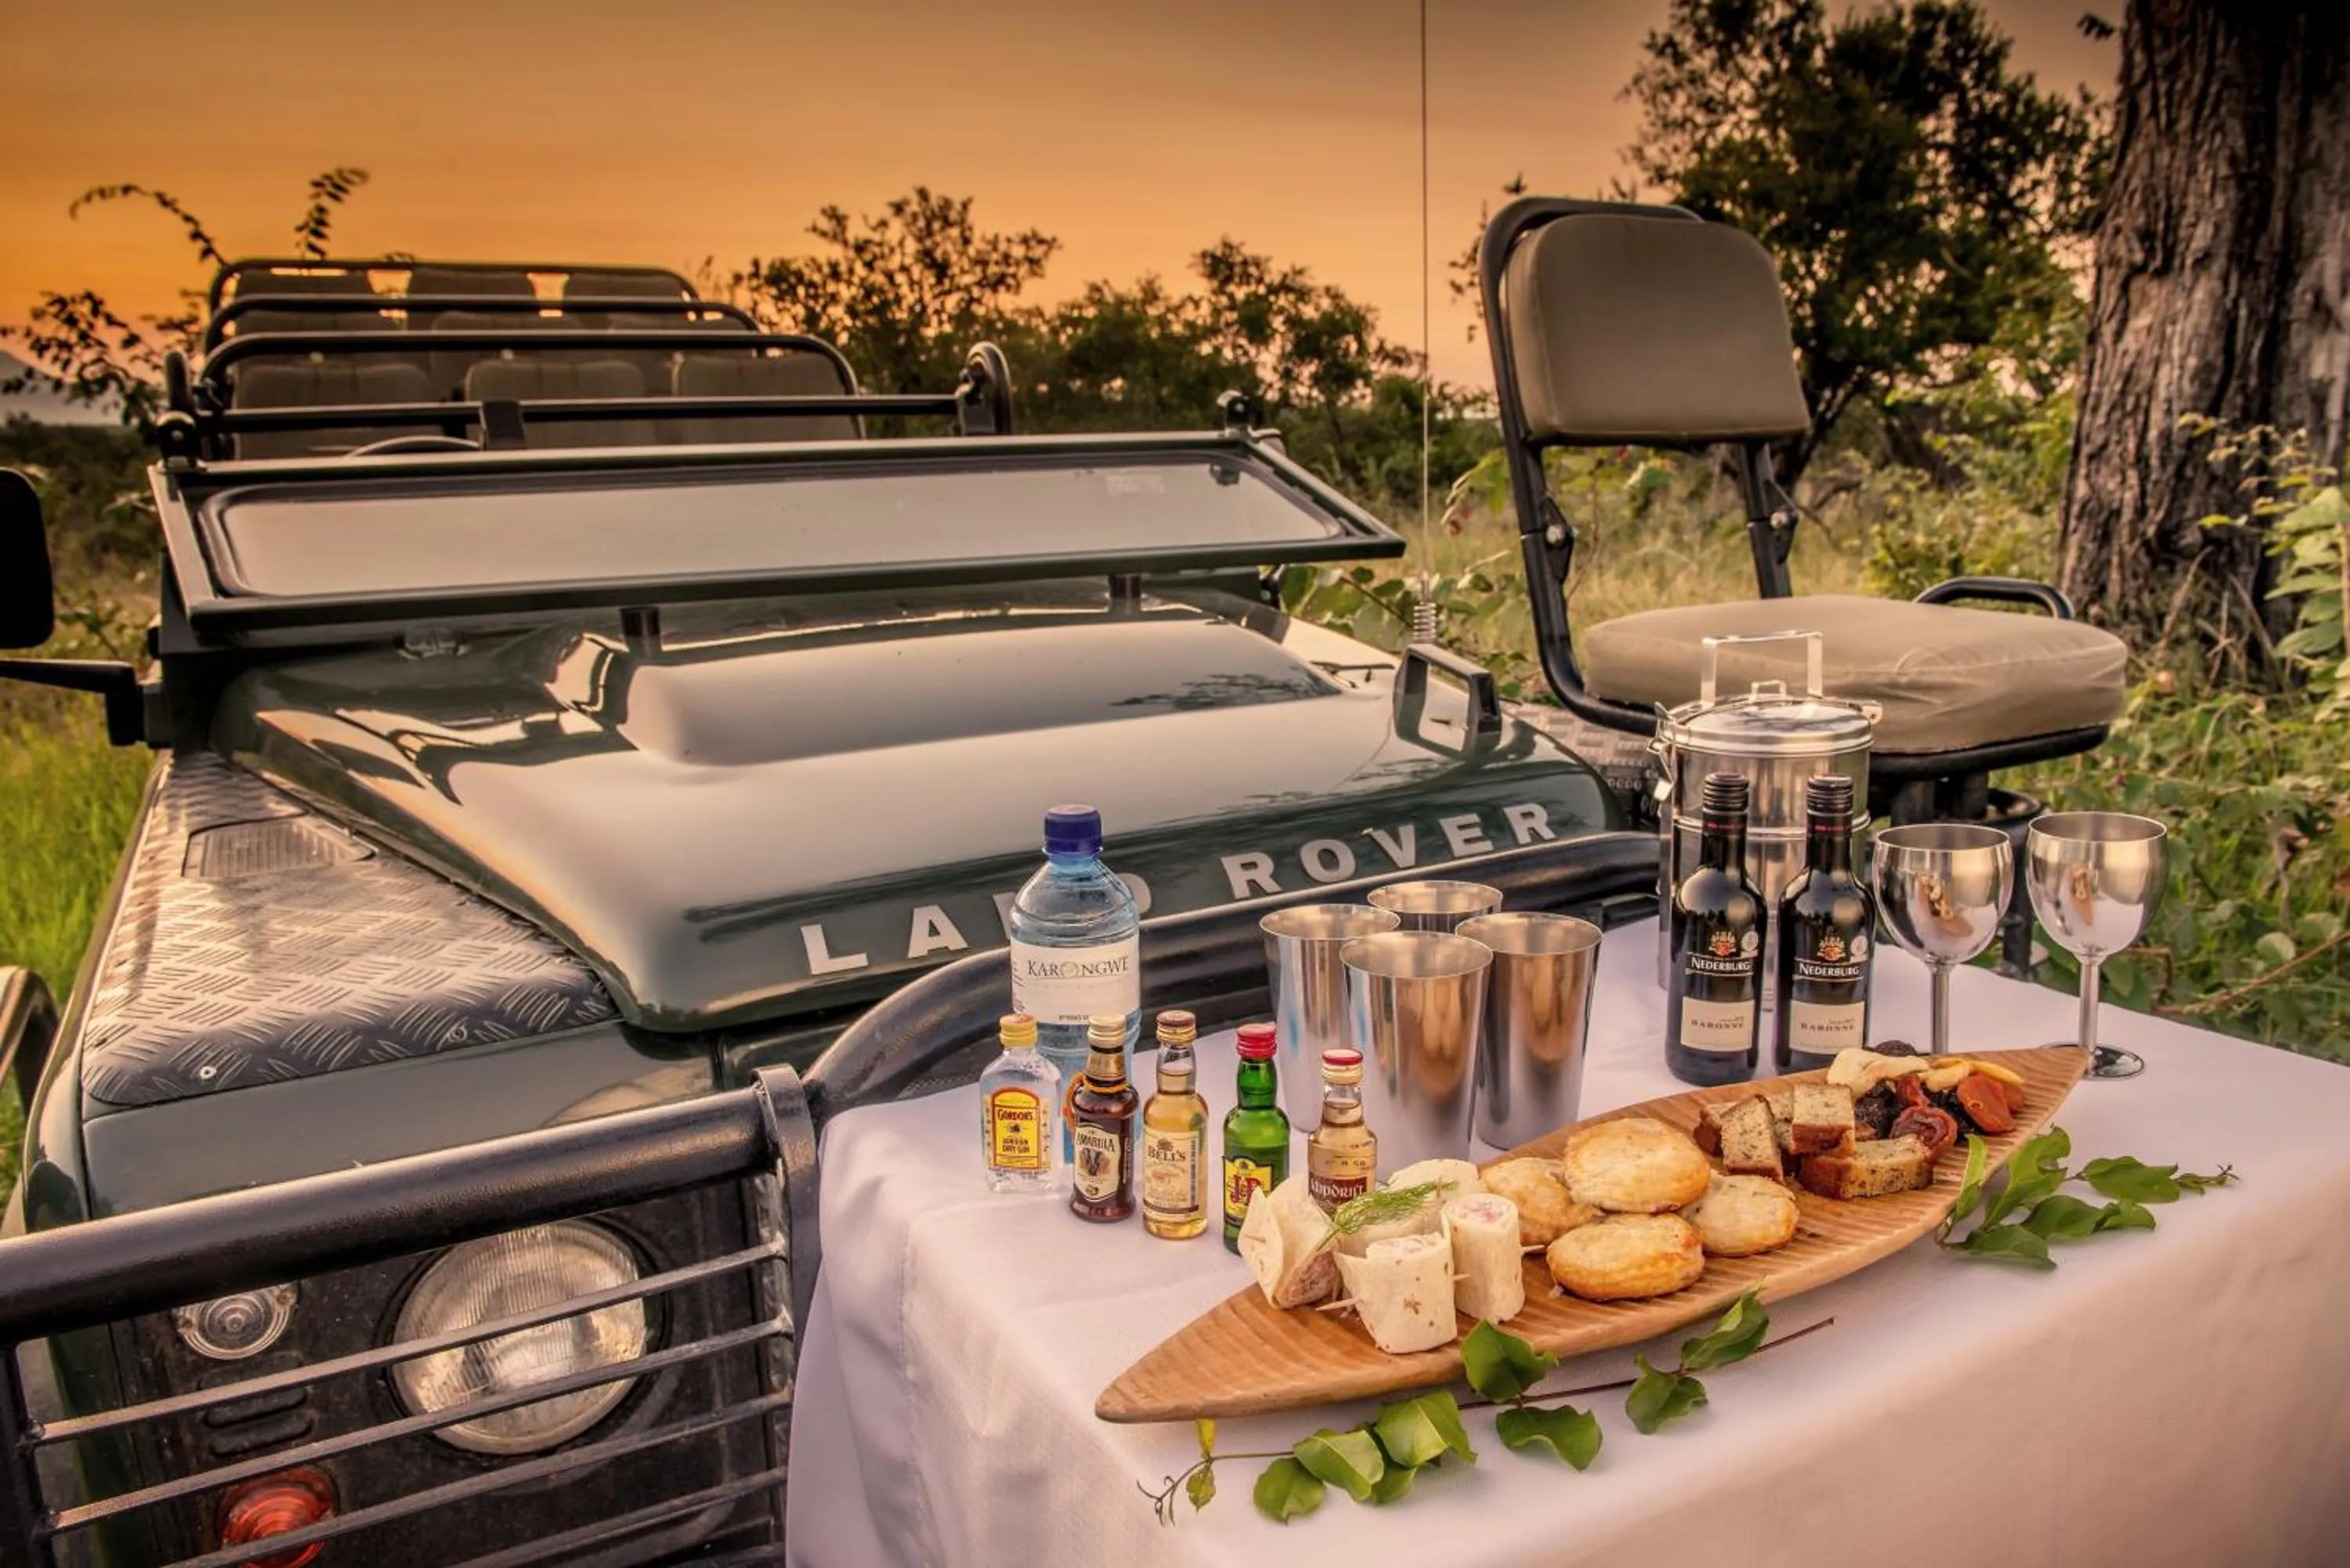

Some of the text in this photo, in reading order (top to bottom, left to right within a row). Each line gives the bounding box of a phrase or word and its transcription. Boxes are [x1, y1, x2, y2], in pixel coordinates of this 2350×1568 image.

[1220, 803, 1557, 900] ROVER
[1027, 956, 1129, 978] KARONGWE
[1691, 957, 1752, 973] NEDERBURG
[1799, 963, 1860, 977] NEDERBURG
[1148, 1145, 1186, 1162] BELL'S
